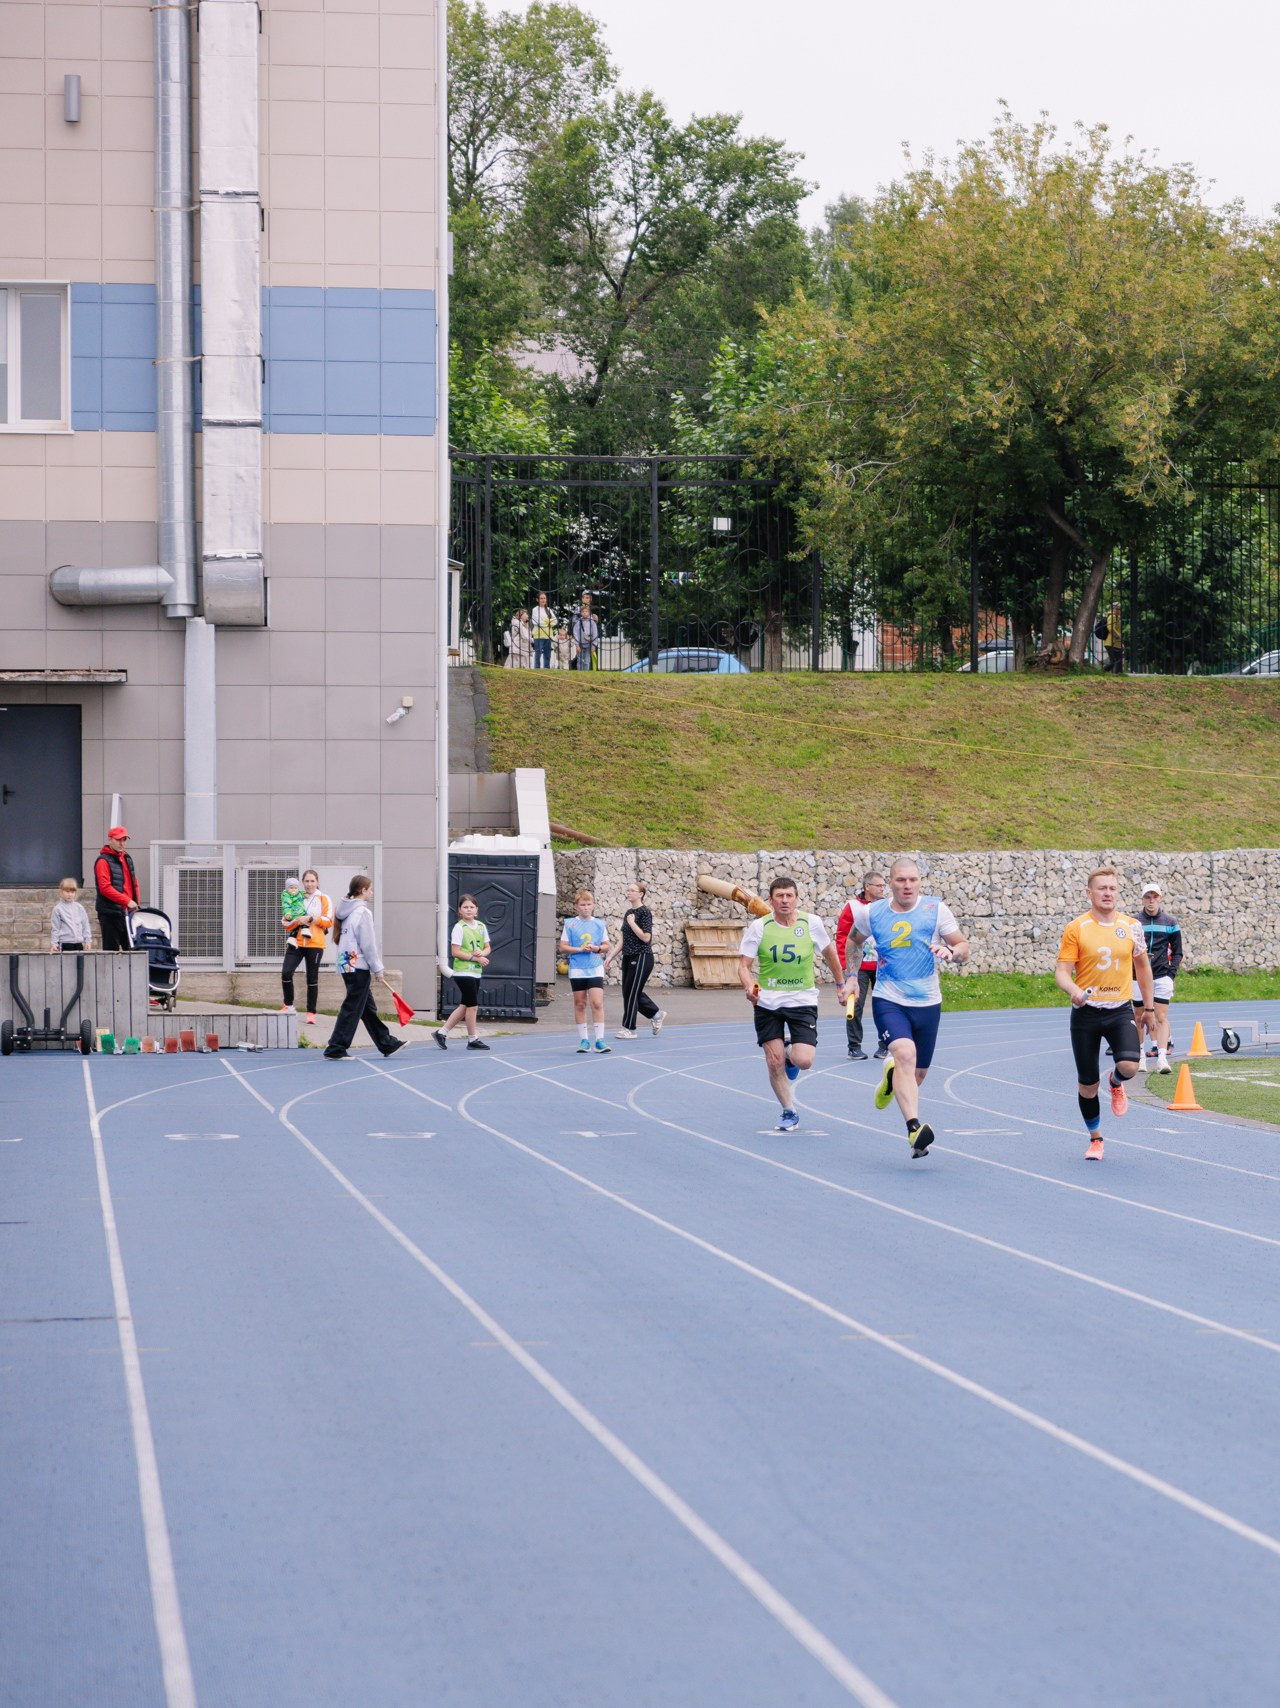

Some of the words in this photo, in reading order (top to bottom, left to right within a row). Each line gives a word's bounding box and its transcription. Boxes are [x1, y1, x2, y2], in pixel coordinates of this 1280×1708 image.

[580, 932, 592, 948] 2
[890, 920, 912, 948] 2
[1096, 946, 1112, 970] 3
[1114, 958, 1119, 971] 1
